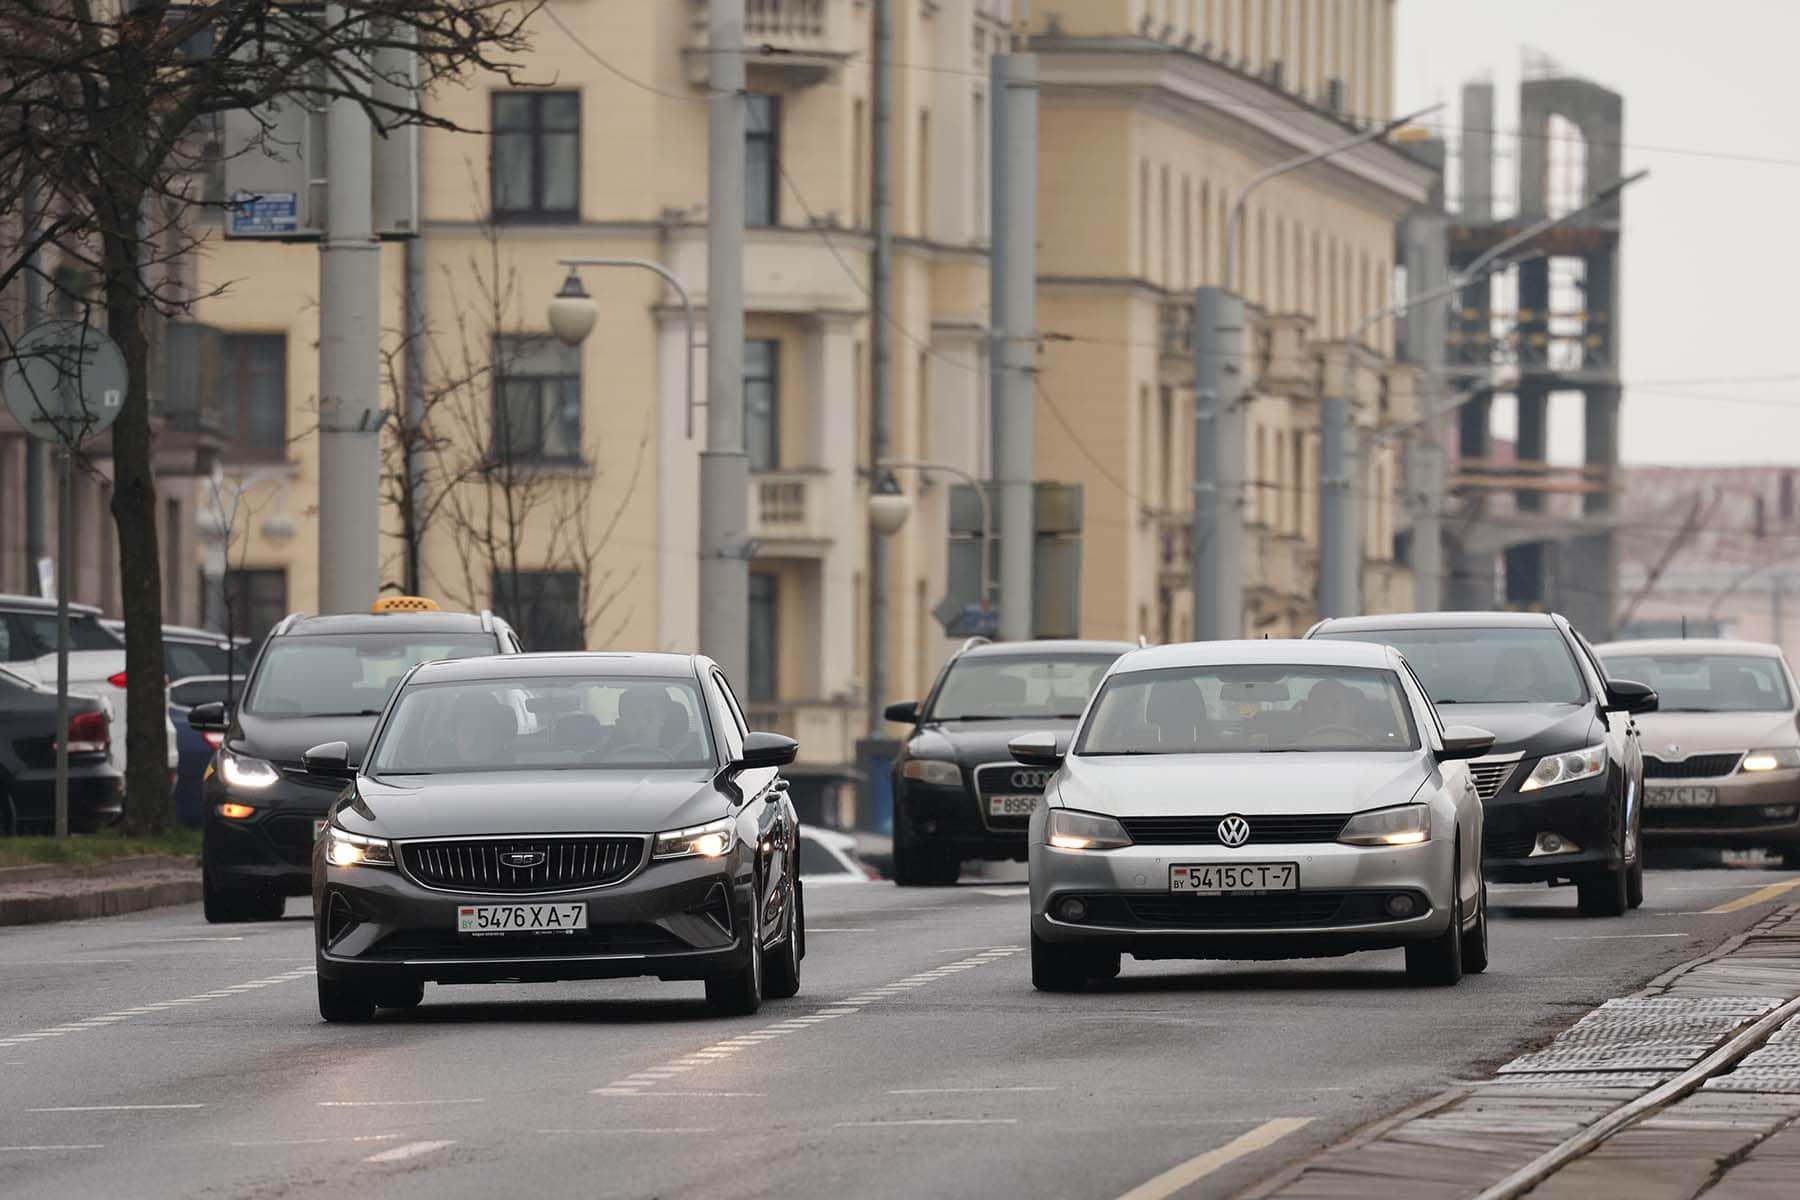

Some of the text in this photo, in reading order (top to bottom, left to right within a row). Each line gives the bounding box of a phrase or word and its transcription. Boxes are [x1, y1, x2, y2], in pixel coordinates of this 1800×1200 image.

[1173, 866, 1293, 889] BY 5415CT-7
[462, 905, 583, 929] BY 5476XA-7
